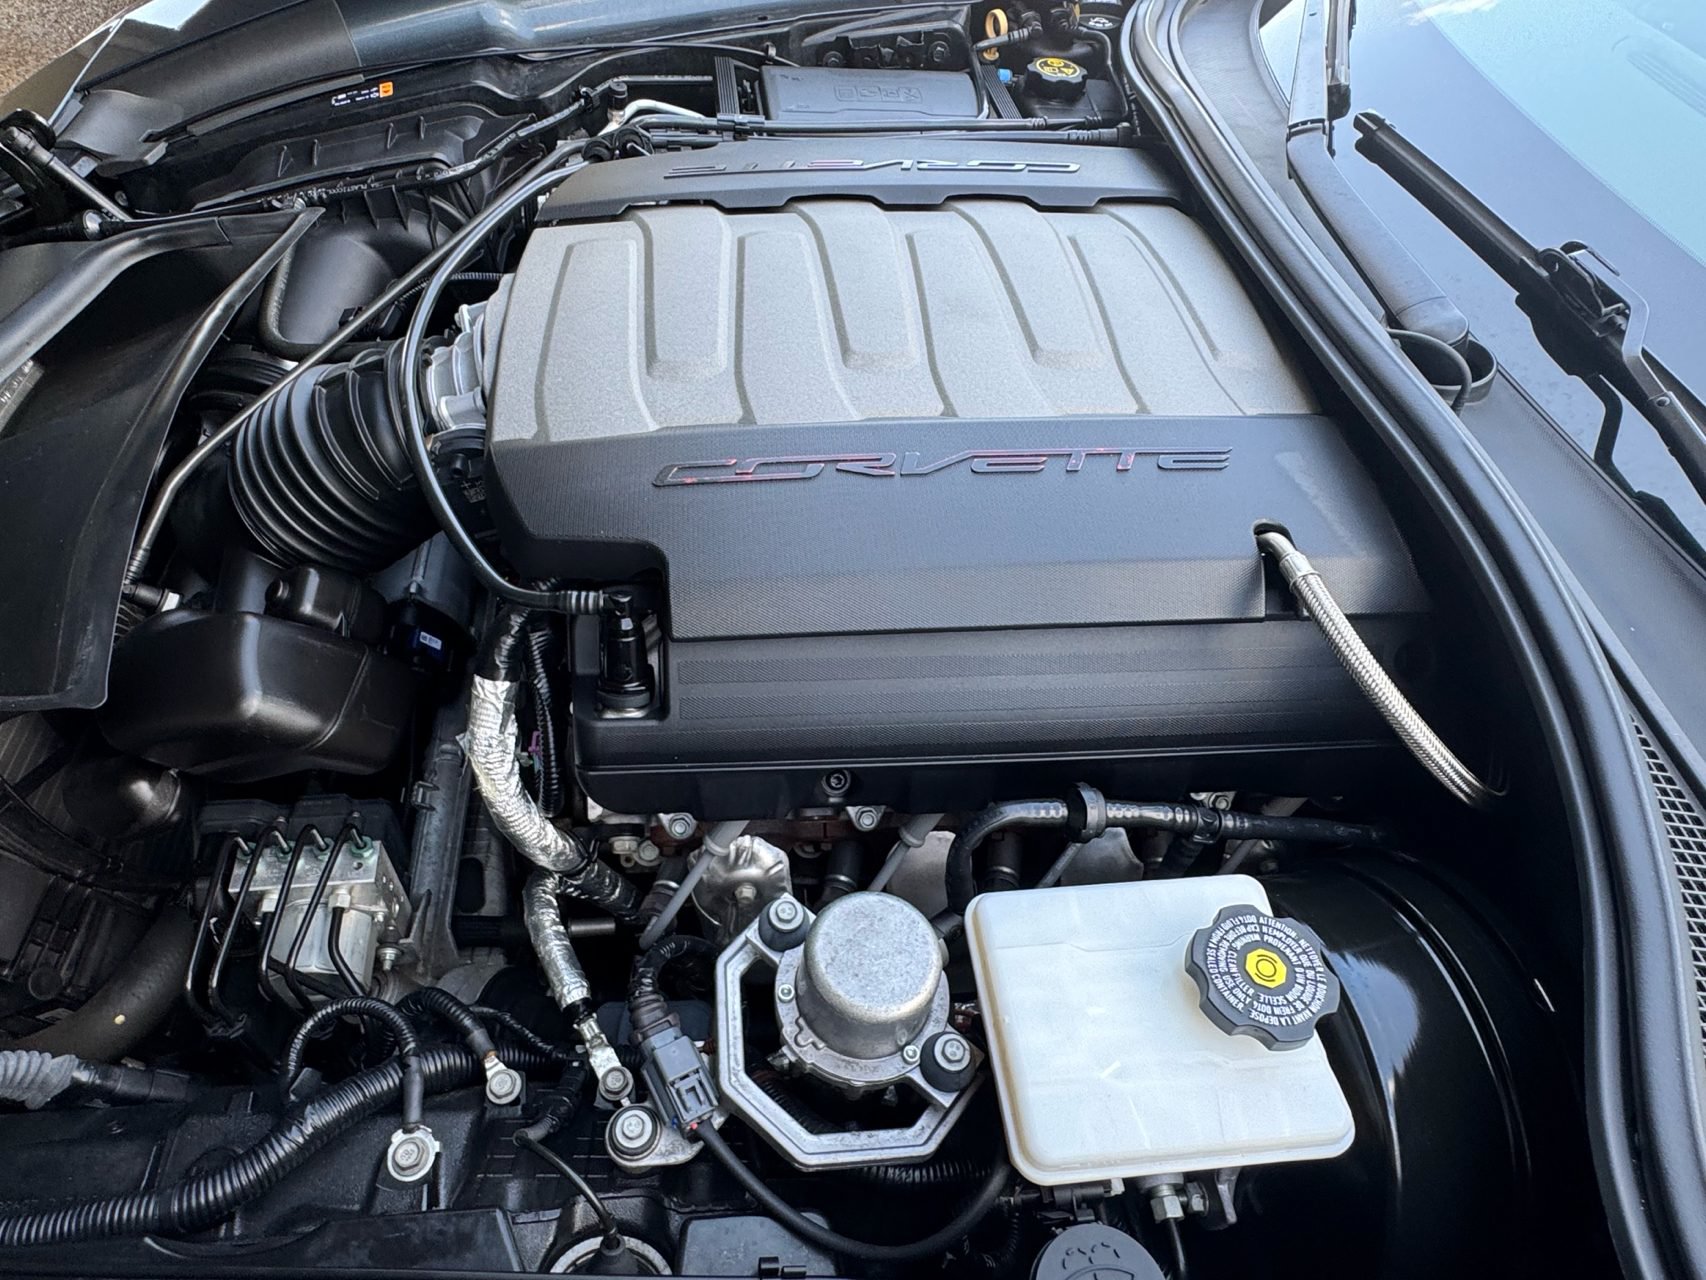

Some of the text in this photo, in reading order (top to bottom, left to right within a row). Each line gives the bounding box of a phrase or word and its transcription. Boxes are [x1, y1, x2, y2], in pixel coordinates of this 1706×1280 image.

[663, 159, 1081, 179] CORVETTE
[652, 446, 1233, 487] CORVETTE
[1220, 917, 1240, 931] FLUID
[1246, 924, 1260, 932] CAP
[1210, 926, 1226, 944] FROM
[1223, 925, 1247, 942] BEFORE
[1206, 948, 1219, 973] SEALED
[1227, 950, 1239, 973] CLEAN
[1298, 938, 1324, 972] NETTOYER
[1299, 954, 1313, 968] QUE
[1264, 934, 1301, 965] PROVENANT
[1285, 984, 1304, 1003] BIDON
[1305, 969, 1316, 980] DU
[1222, 975, 1236, 989] USE
[1231, 973, 1255, 996] FILLER
[1315, 973, 1328, 983] LE
[1211, 973, 1244, 1012] CONTAINER.
[1232, 987, 1252, 1004] ONLY
[1300, 980, 1316, 1005] LIQUIDE
[1308, 983, 1328, 1014] BOUCHON
[1273, 1004, 1296, 1015] FREIN
[1292, 999, 1305, 1011] DE
[1279, 1016, 1293, 1026] LA
[1290, 1007, 1313, 1025] AVANT
